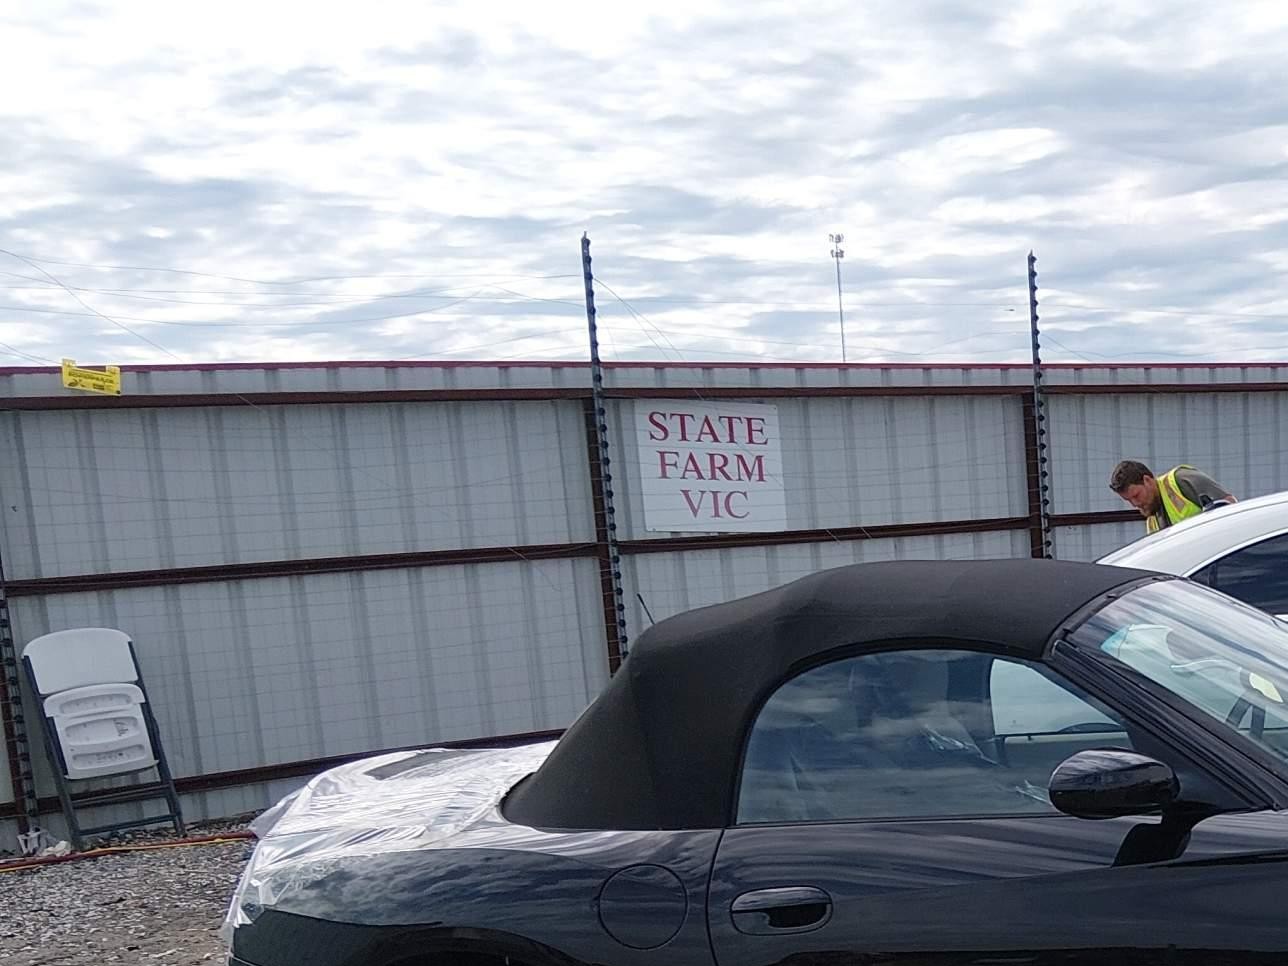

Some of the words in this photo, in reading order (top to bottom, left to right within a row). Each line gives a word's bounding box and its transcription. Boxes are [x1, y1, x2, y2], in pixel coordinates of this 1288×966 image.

[648, 411, 769, 446] STATE
[656, 450, 768, 483] FARM
[680, 489, 750, 519] VIC
